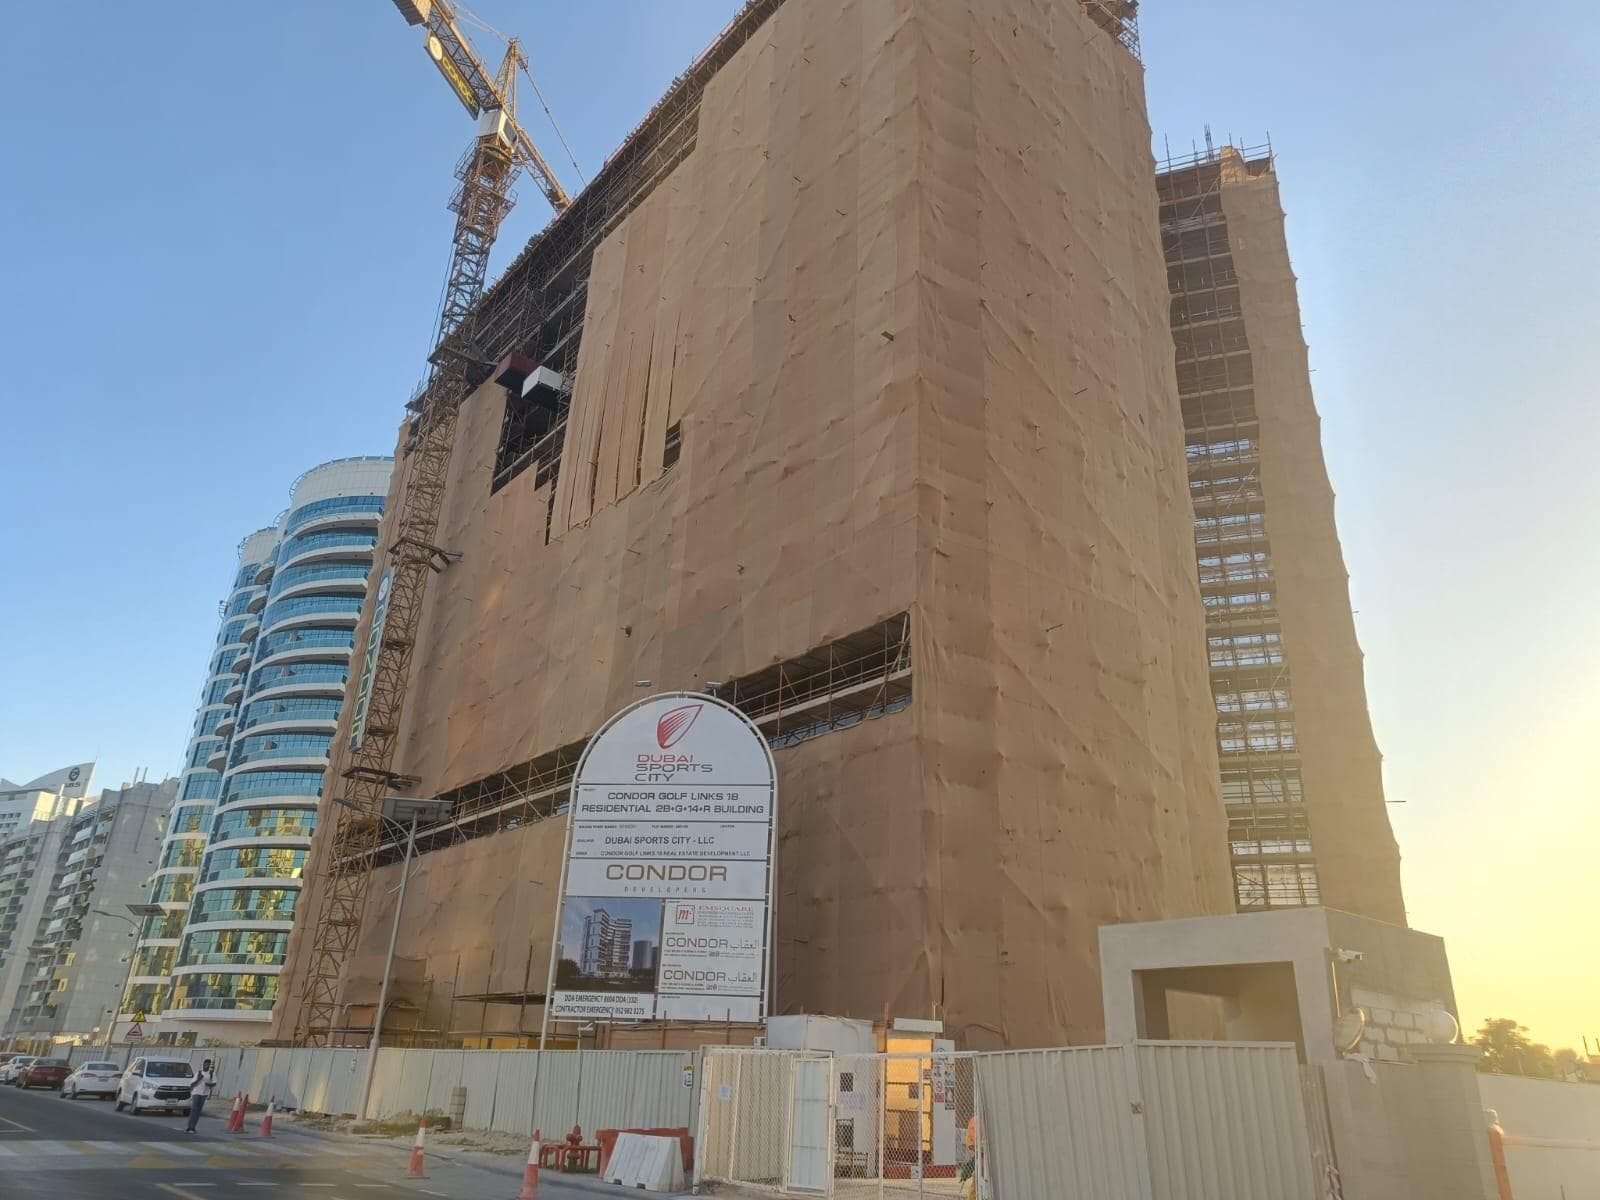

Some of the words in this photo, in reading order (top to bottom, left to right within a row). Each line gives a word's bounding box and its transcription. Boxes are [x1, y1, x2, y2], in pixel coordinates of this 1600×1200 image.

[637, 754, 693, 763] DUBAI
[636, 763, 713, 772] SPORTS
[635, 773, 675, 782] CITY
[607, 792, 655, 801] CONDOR
[658, 792, 688, 801] GOLF
[691, 792, 724, 801] LINKS
[581, 804, 652, 813] RESIDENTIAL
[714, 805, 764, 814] BUILDING
[605, 836, 632, 845] DUBAI
[634, 836, 670, 845] SPORTS
[671, 836, 691, 845] CITY
[698, 836, 715, 845] LLC
[606, 863, 727, 882] CONDOR
[624, 886, 707, 894] DEVELOPERS
[666, 937, 728, 949] CONDOR
[663, 969, 726, 982] CONDOR
